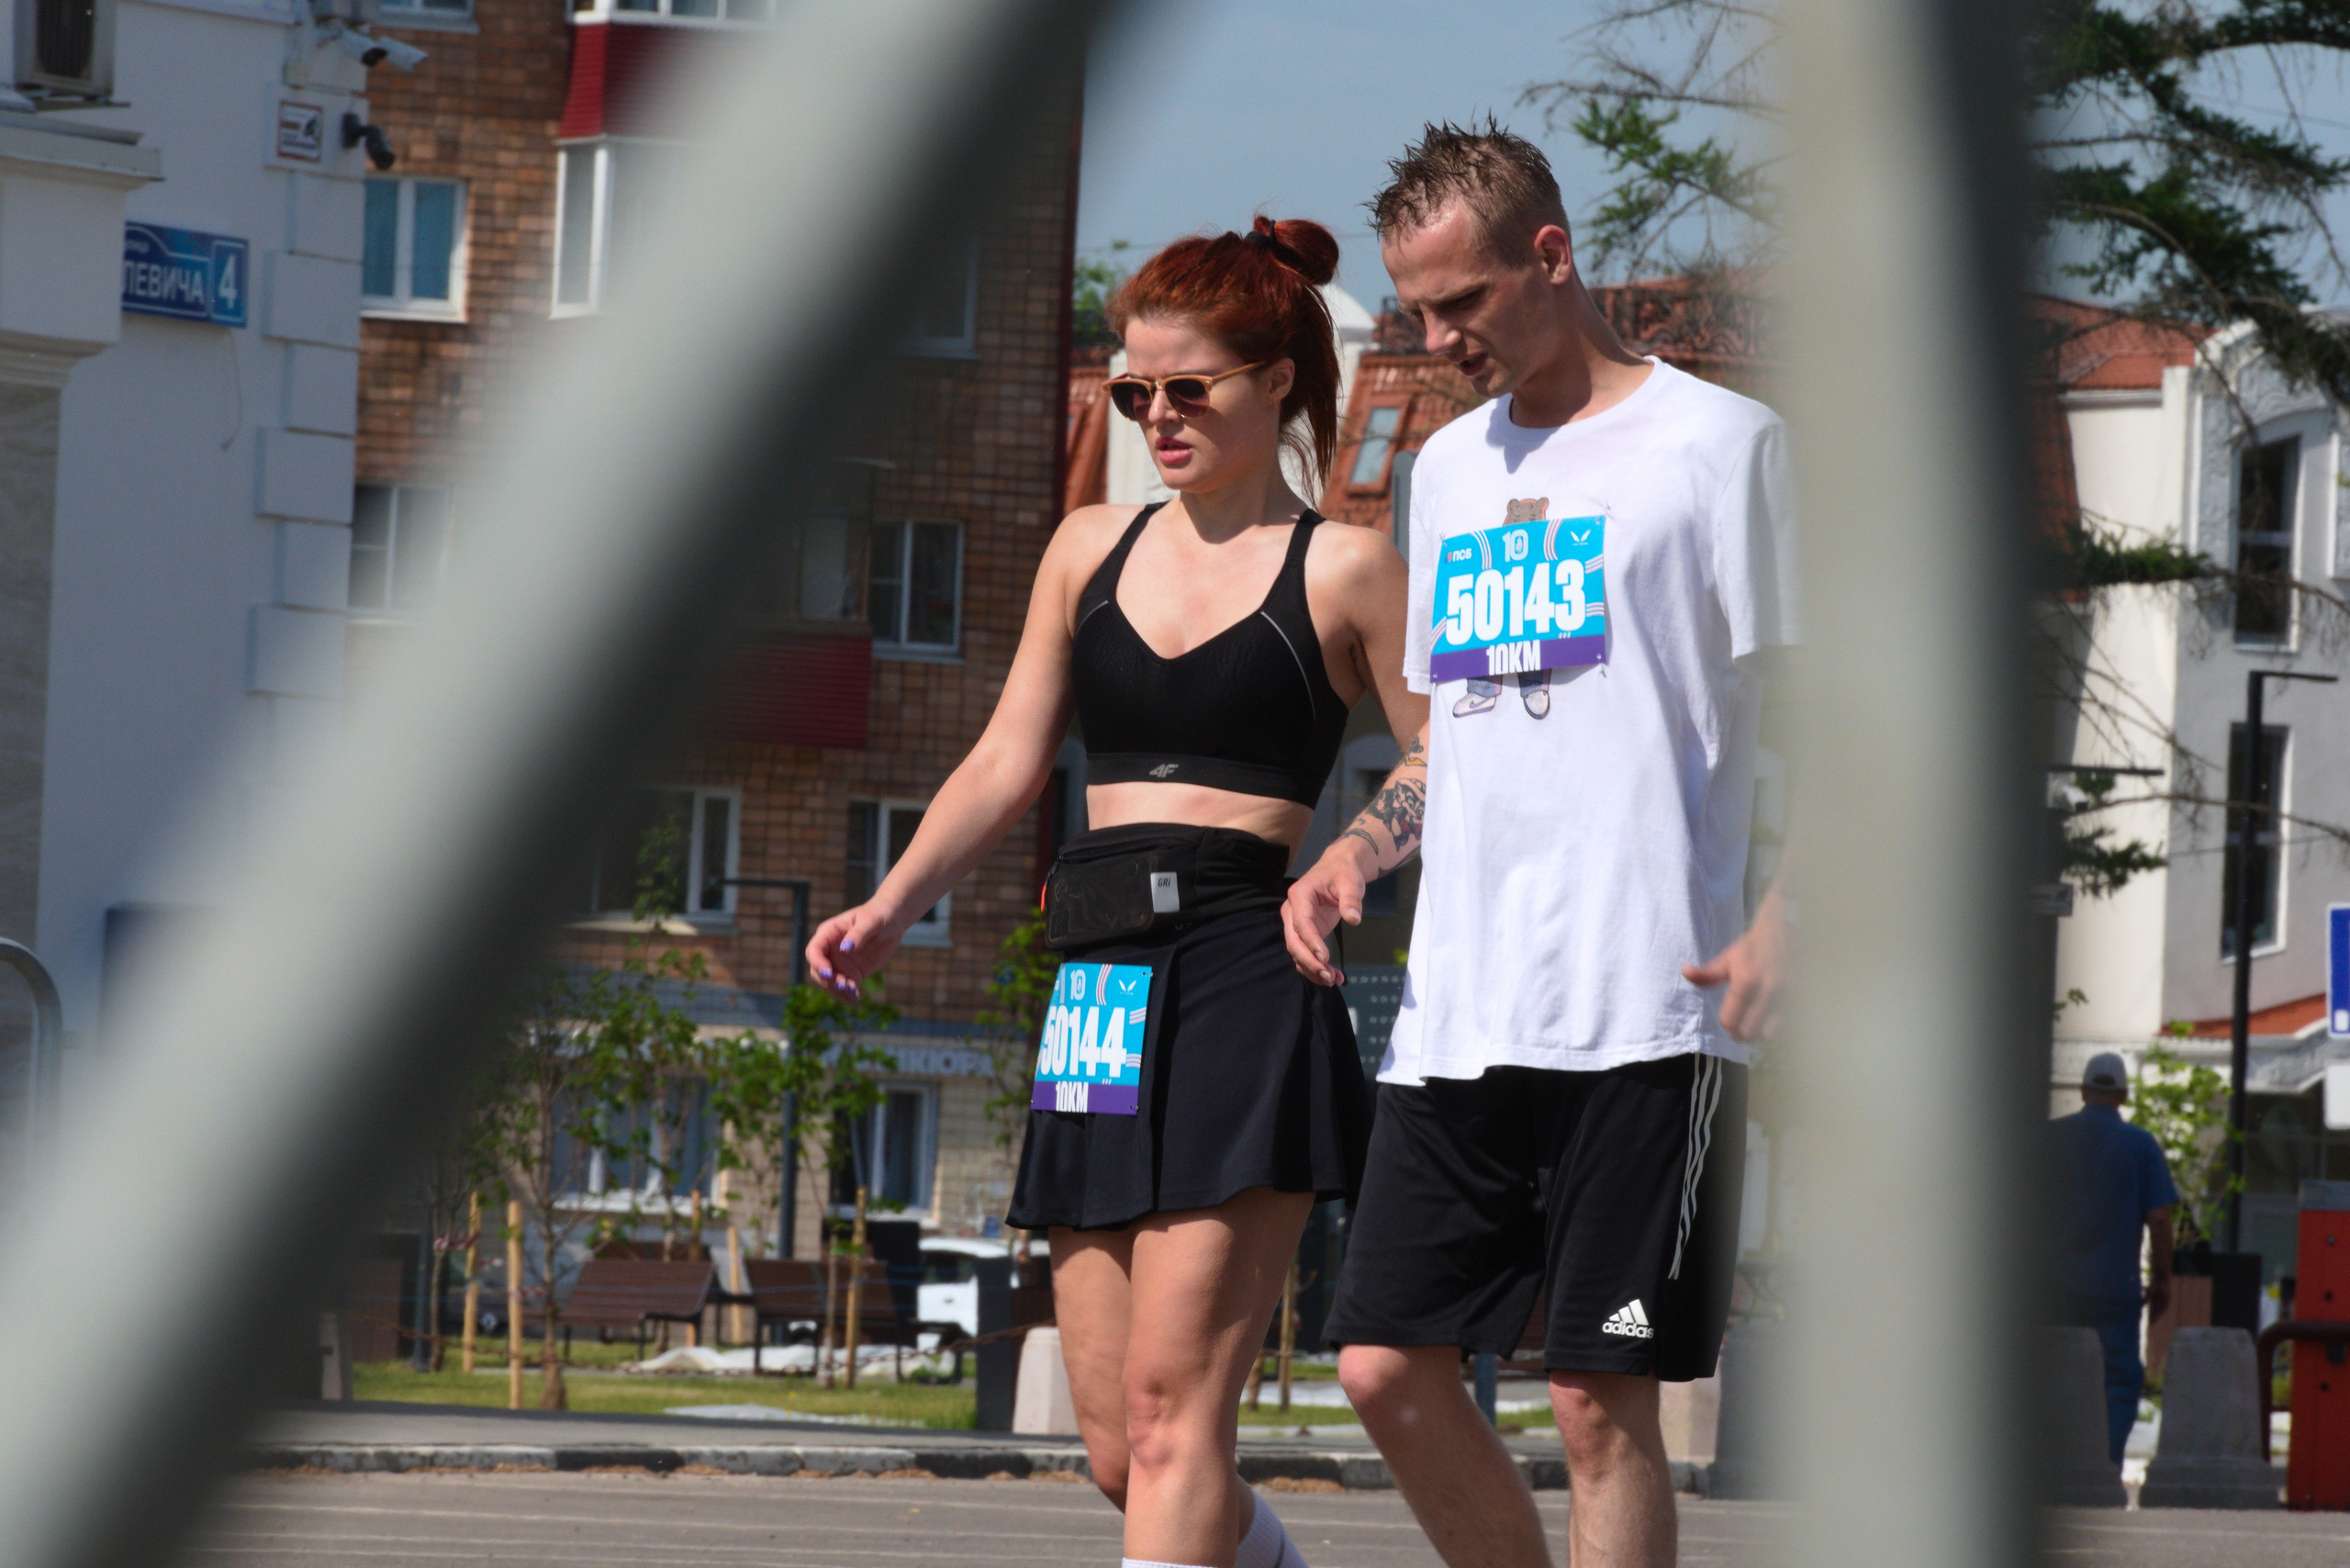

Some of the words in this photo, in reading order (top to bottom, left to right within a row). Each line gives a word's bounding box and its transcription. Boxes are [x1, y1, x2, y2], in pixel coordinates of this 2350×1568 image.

[218, 254, 238, 310] 4
[1452, 548, 1472, 562] ПСБ
[1446, 559, 1586, 645] 50143
[1148, 763, 1180, 778] 4F
[1040, 1004, 1128, 1079] 50144
[1602, 1321, 1654, 1339] adidas
